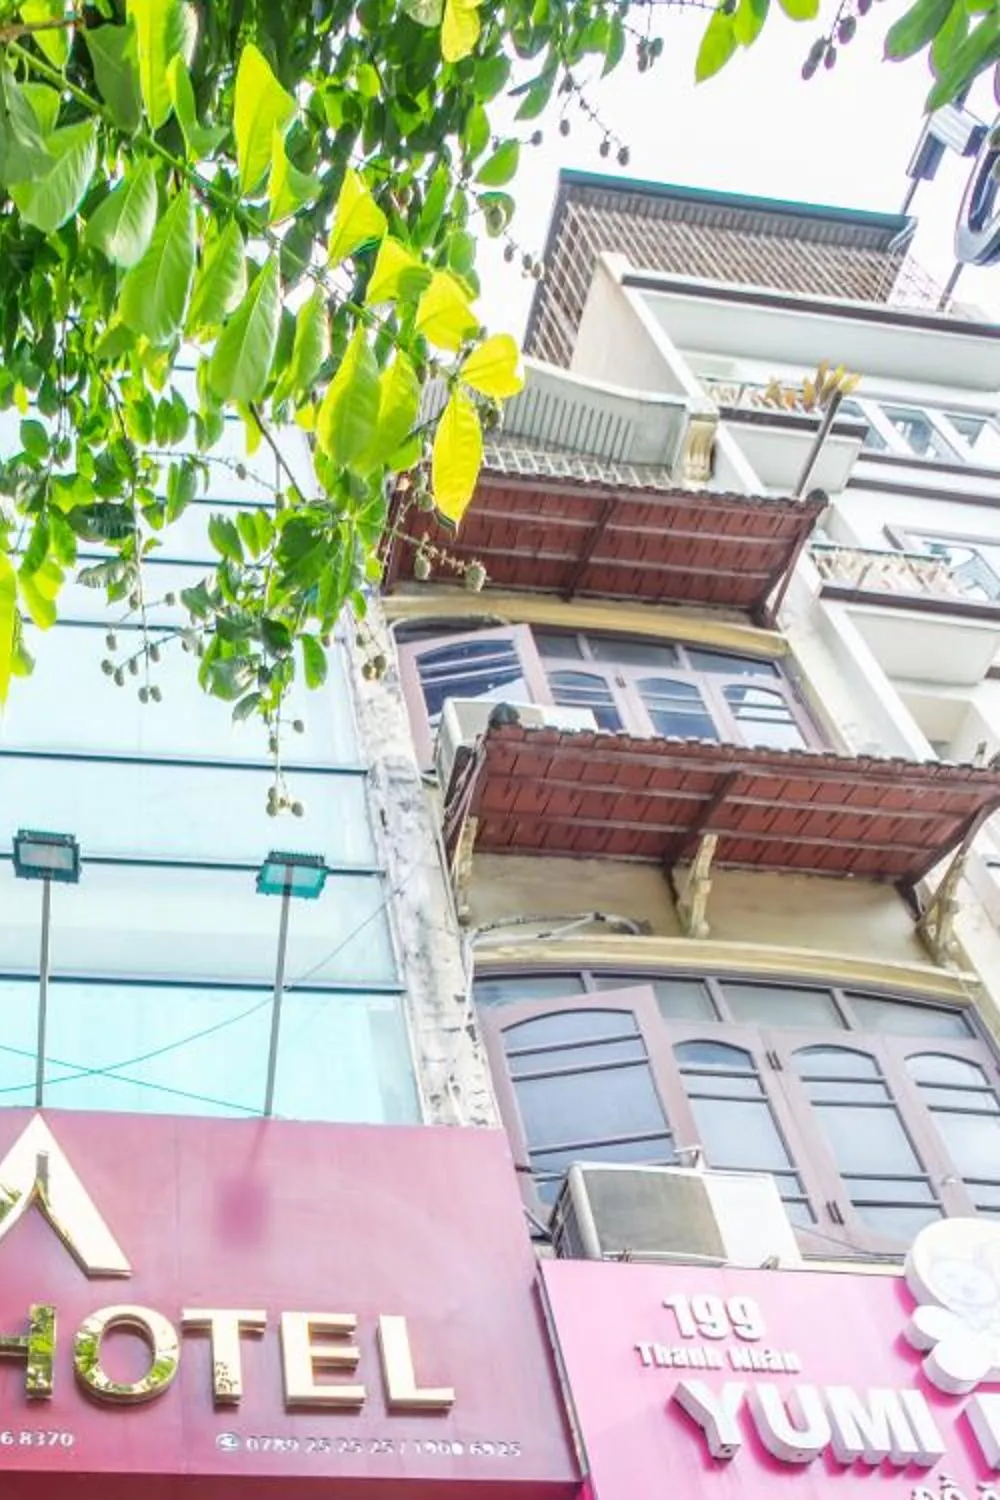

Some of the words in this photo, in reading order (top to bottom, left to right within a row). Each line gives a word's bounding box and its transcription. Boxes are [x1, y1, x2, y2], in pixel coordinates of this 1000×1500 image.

[661, 1293, 766, 1342] 199
[634, 1342, 723, 1371] Thanh
[19, 1431, 75, 1447] 8370
[672, 1379, 946, 1465] YUMI
